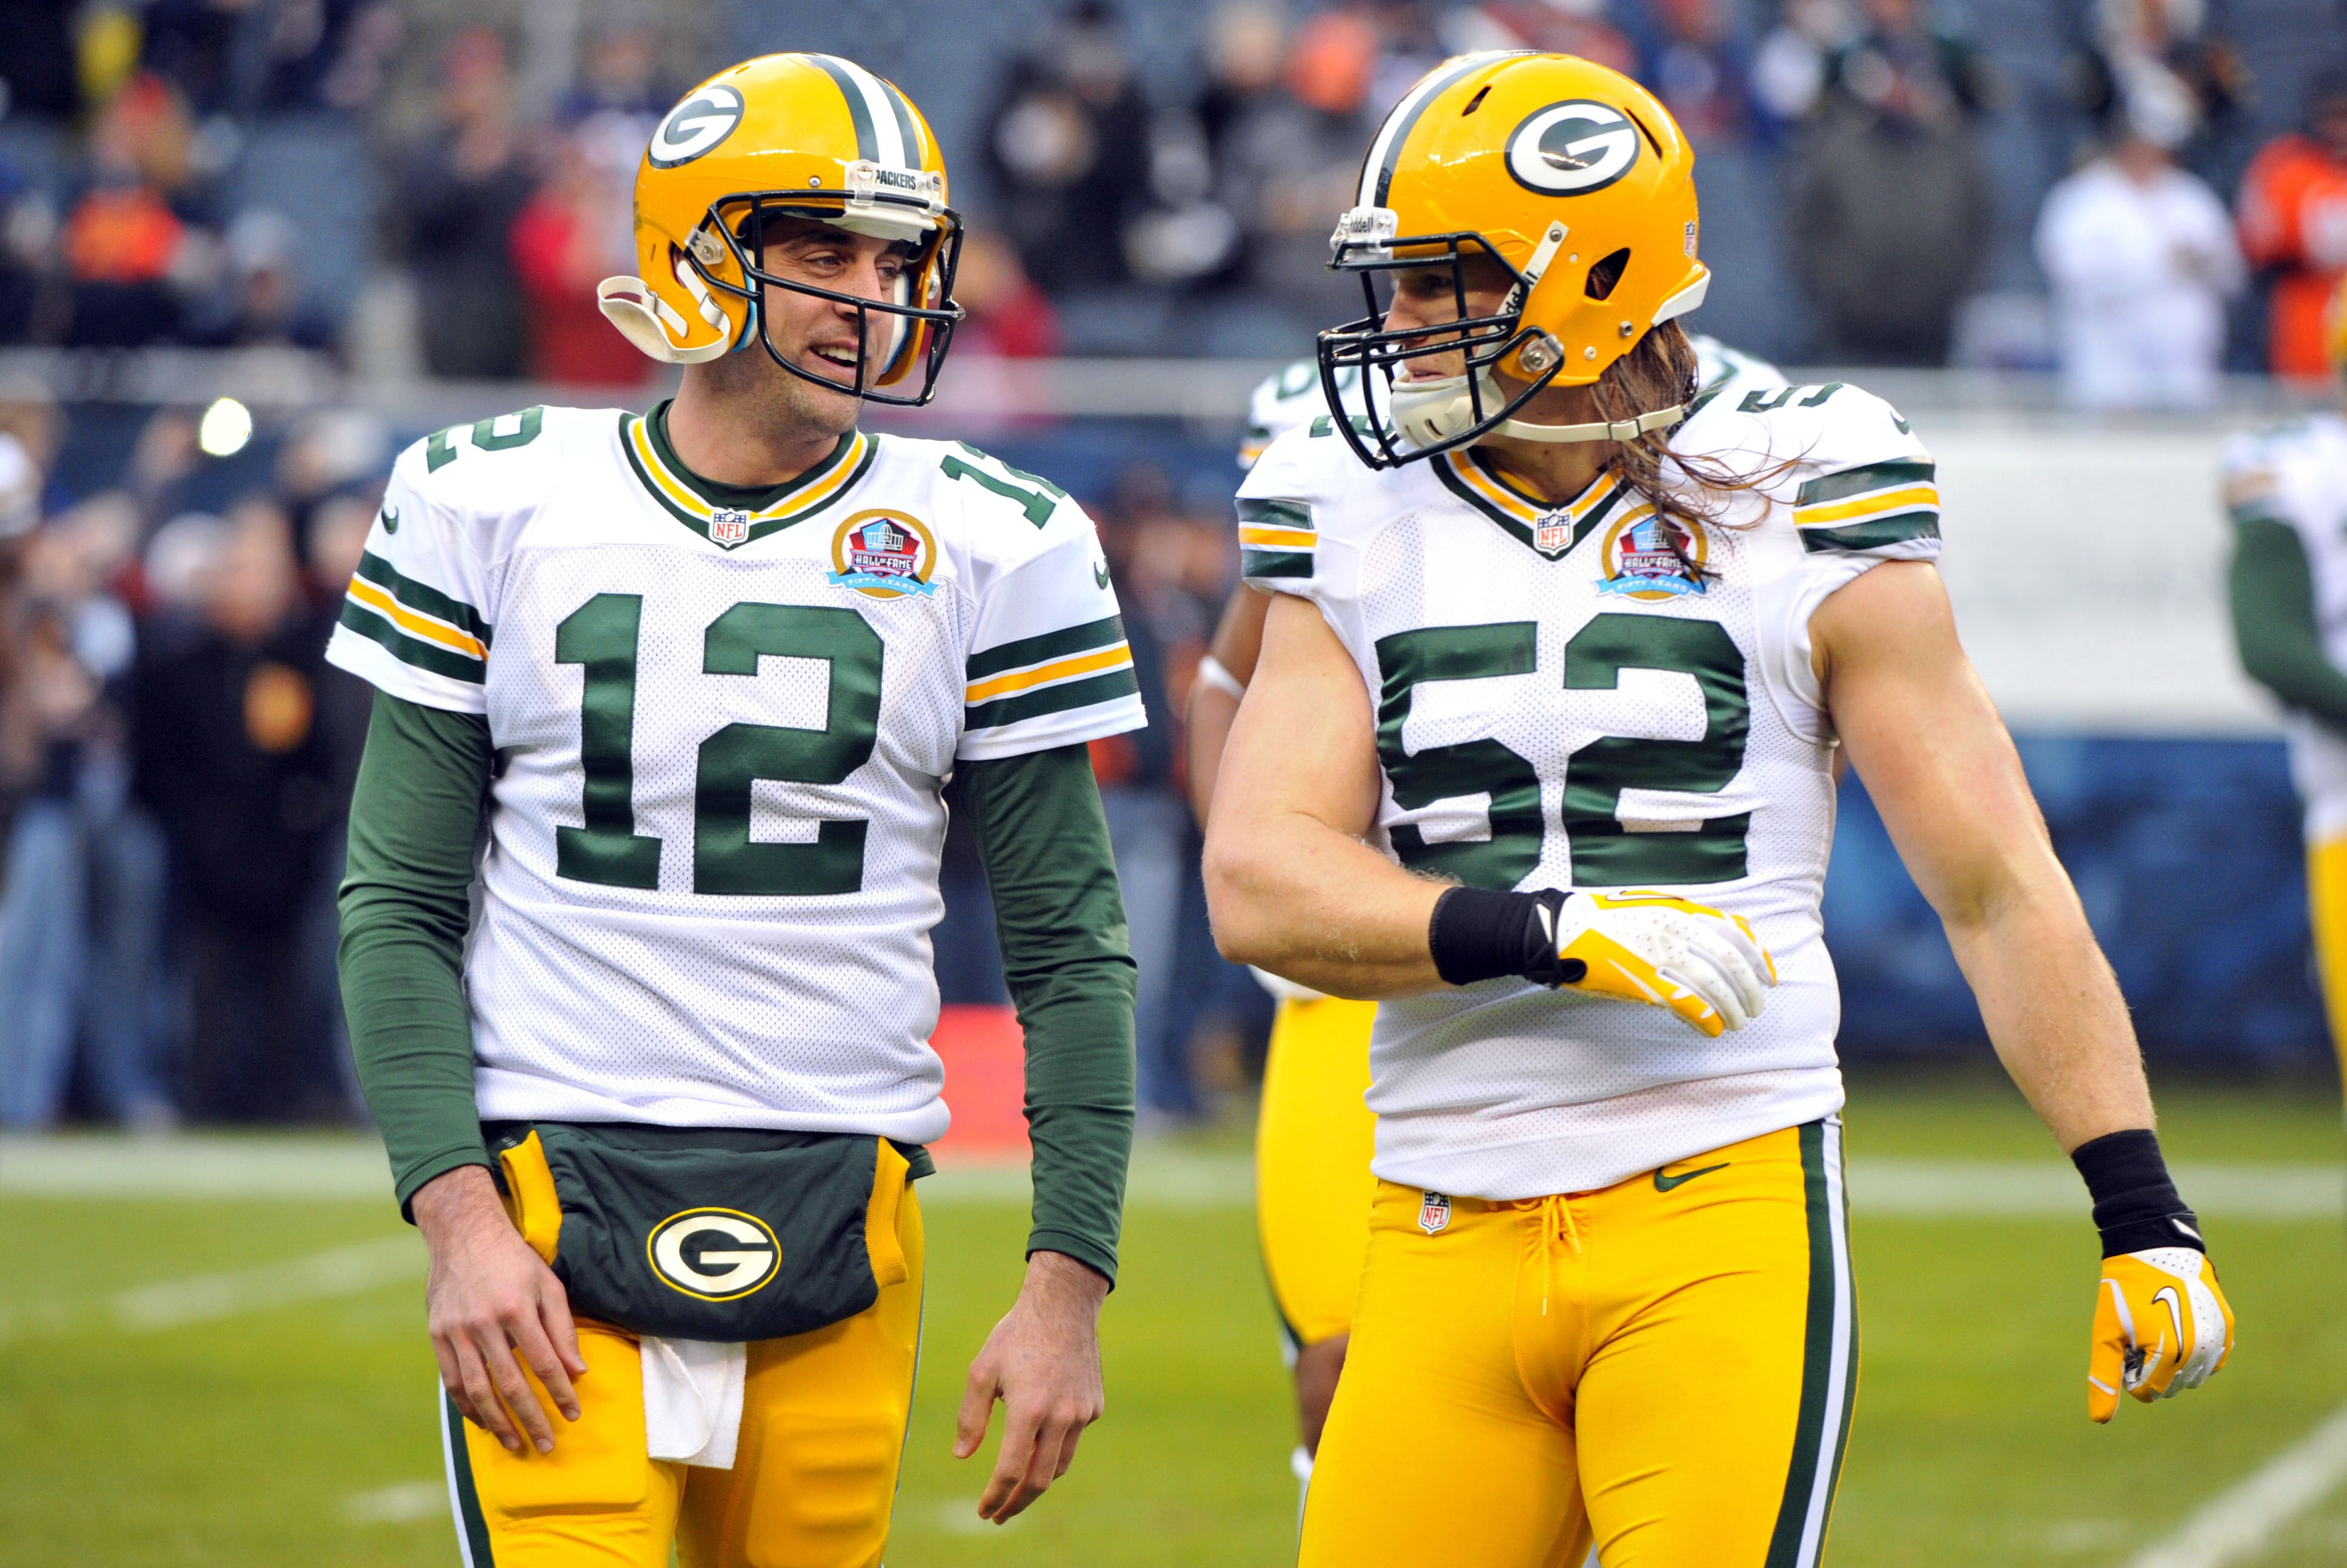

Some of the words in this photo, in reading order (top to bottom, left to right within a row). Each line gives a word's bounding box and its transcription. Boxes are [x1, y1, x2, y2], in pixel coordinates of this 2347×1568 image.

[649, 88, 739, 164] G
[1510, 104, 1636, 190] G
[875, 169, 916, 190] PACKERS
[715, 523, 743, 539] NFL
[1540, 527, 1567, 547] NFL
[855, 555, 880, 566] HALL
[887, 559, 912, 570] FAME
[1624, 557, 1650, 568] HALL
[1656, 557, 1682, 568] FAME
[881, 578, 916, 592] YEARS
[1617, 579, 1647, 590] FIFTY
[1652, 579, 1688, 592] YEARS
[555, 592, 885, 897] 12
[1374, 612, 1751, 892] 52
[1424, 1207, 1446, 1227] NFL
[656, 1215, 774, 1293] G
